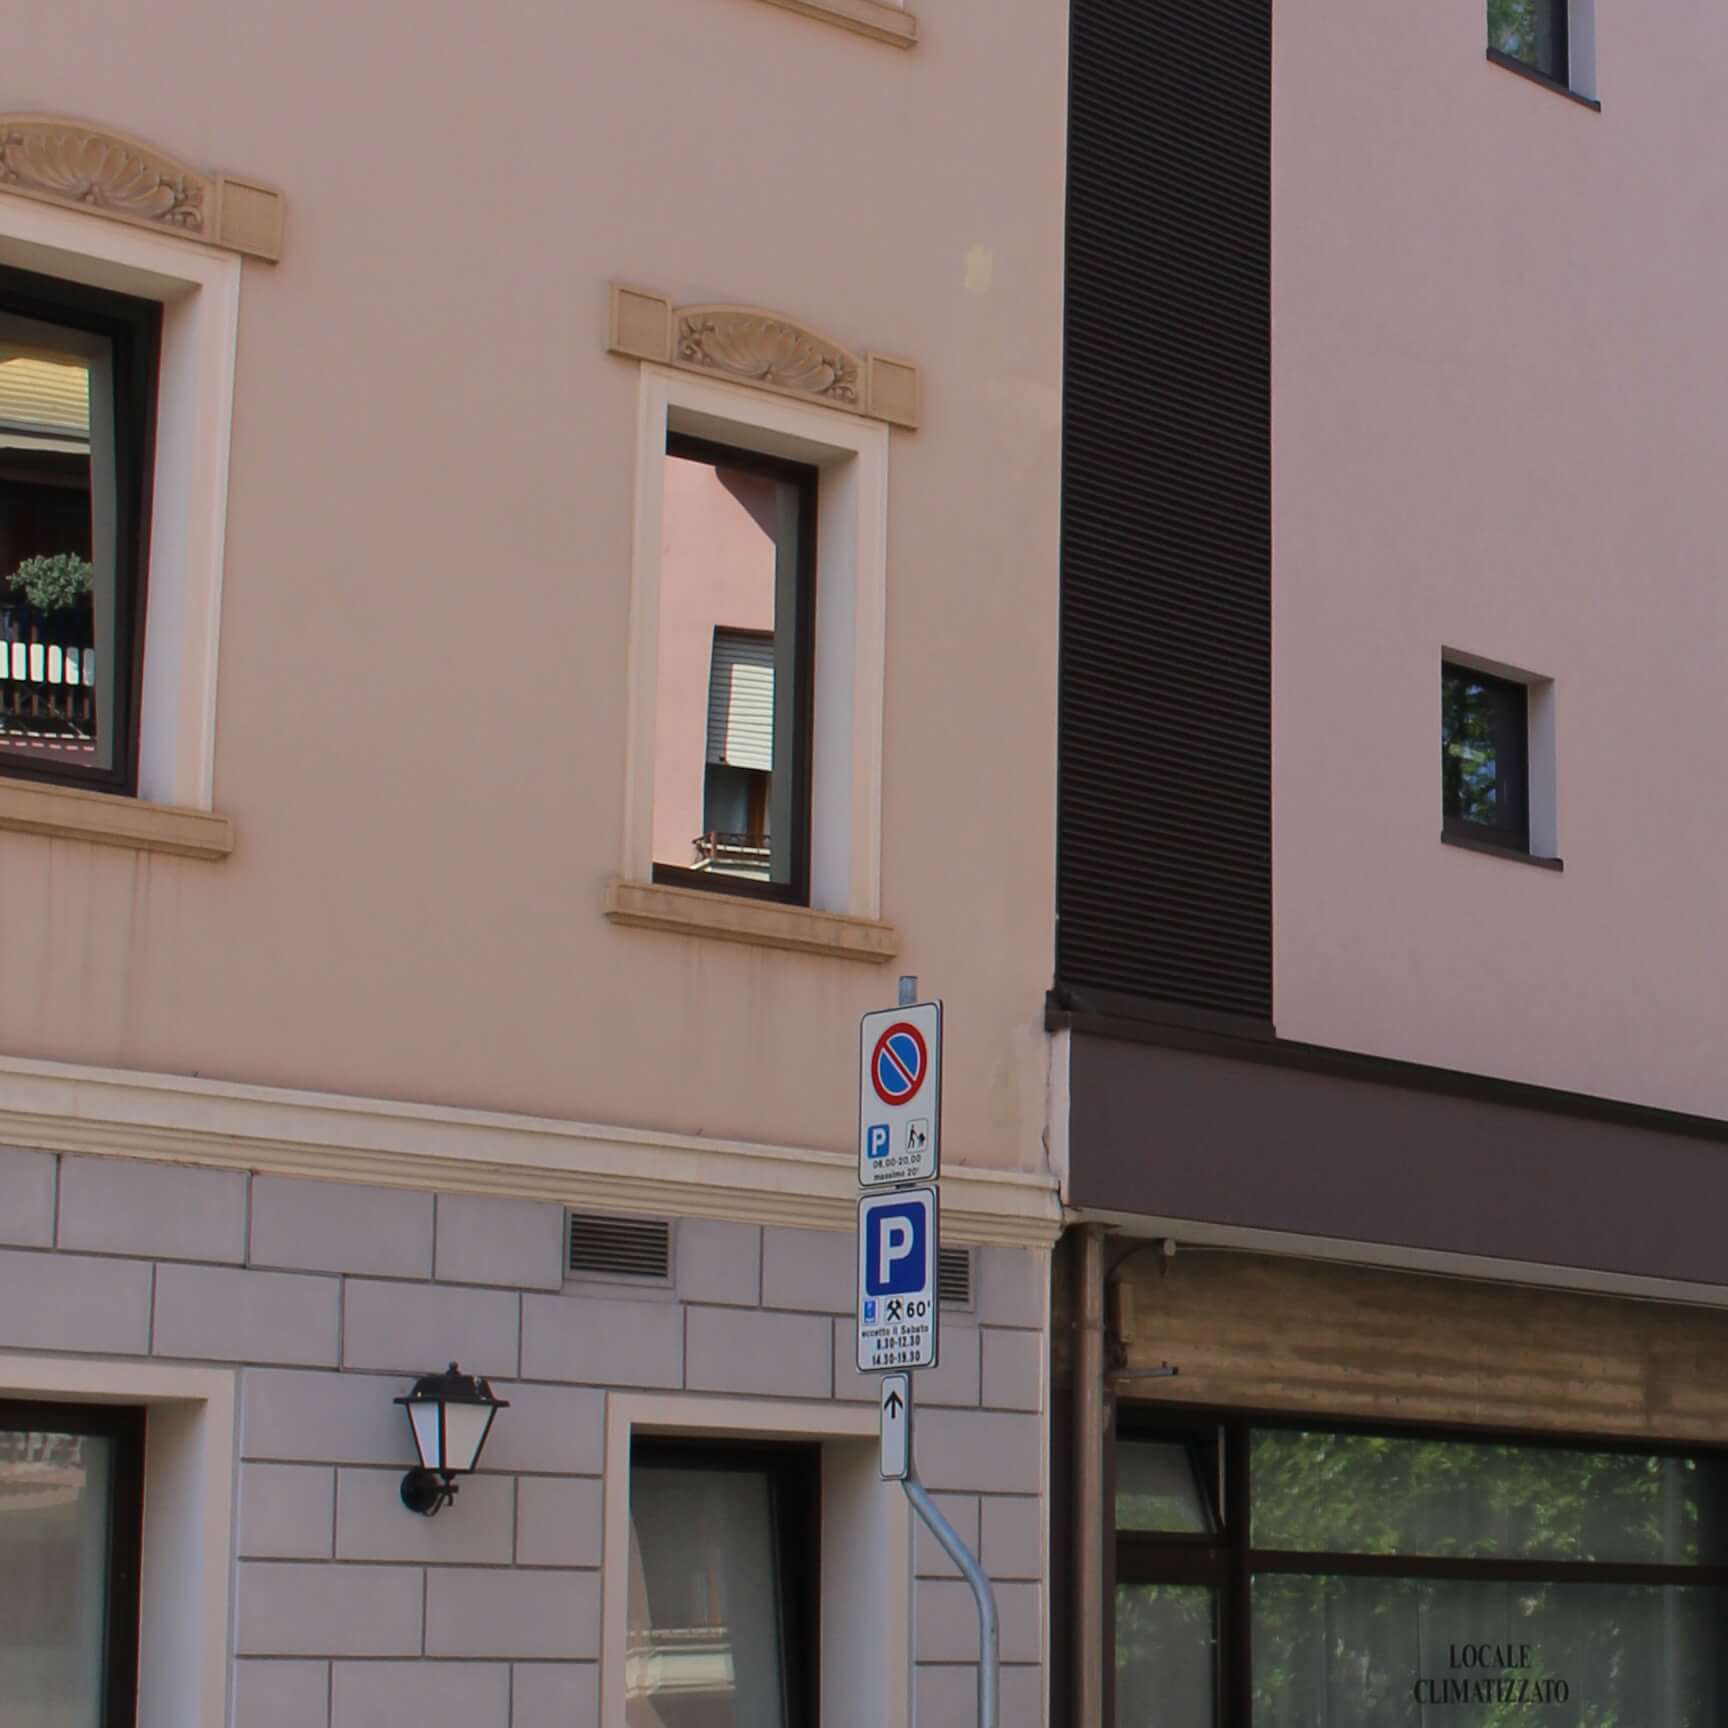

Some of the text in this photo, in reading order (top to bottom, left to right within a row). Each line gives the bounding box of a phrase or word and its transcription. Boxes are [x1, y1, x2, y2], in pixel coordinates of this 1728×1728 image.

[872, 1128, 886, 1155] P
[879, 1216, 914, 1283] P
[906, 1300, 931, 1318] 60'
[901, 1325, 929, 1335] Sabato
[1449, 1643, 1532, 1669] LOCALE
[1414, 1679, 1569, 1704] CLIMATIZZATO
